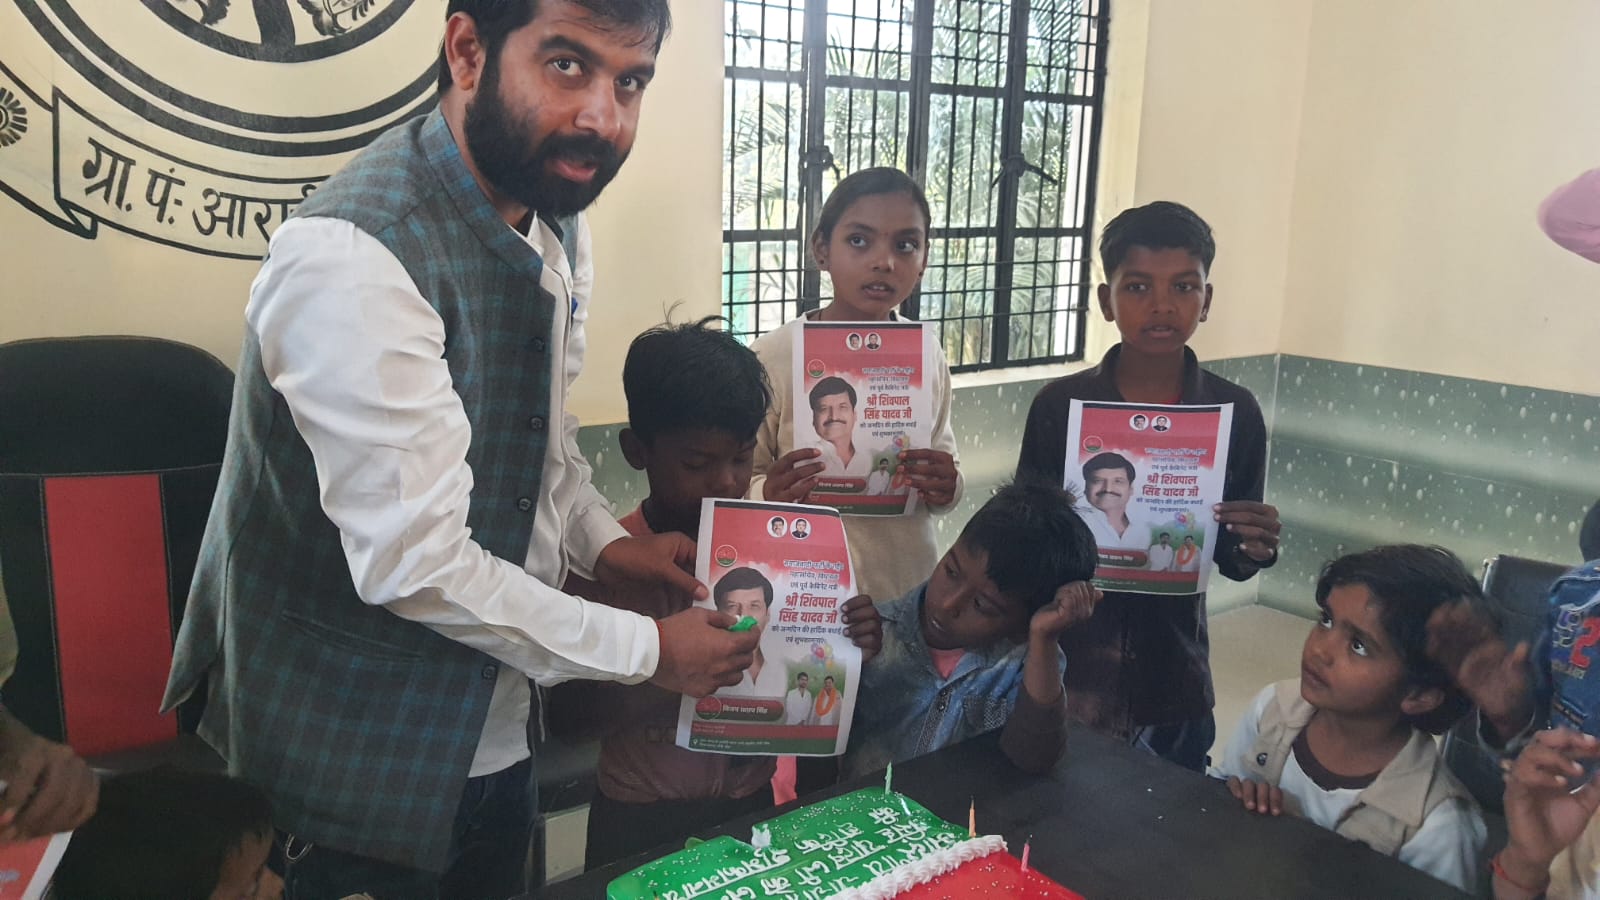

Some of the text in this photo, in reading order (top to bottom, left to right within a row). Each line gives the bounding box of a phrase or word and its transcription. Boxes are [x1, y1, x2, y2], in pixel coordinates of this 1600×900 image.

[866, 393, 910, 406] श्री शिवपाल
[864, 406, 912, 420] सिंह यादव जी
[1147, 472, 1198, 485] श्री शिवपाल
[1142, 484, 1199, 497] सिंह यादव जी
[785, 591, 838, 609] श्री शिवपाल
[779, 607, 838, 624] सिंह यादव जी
